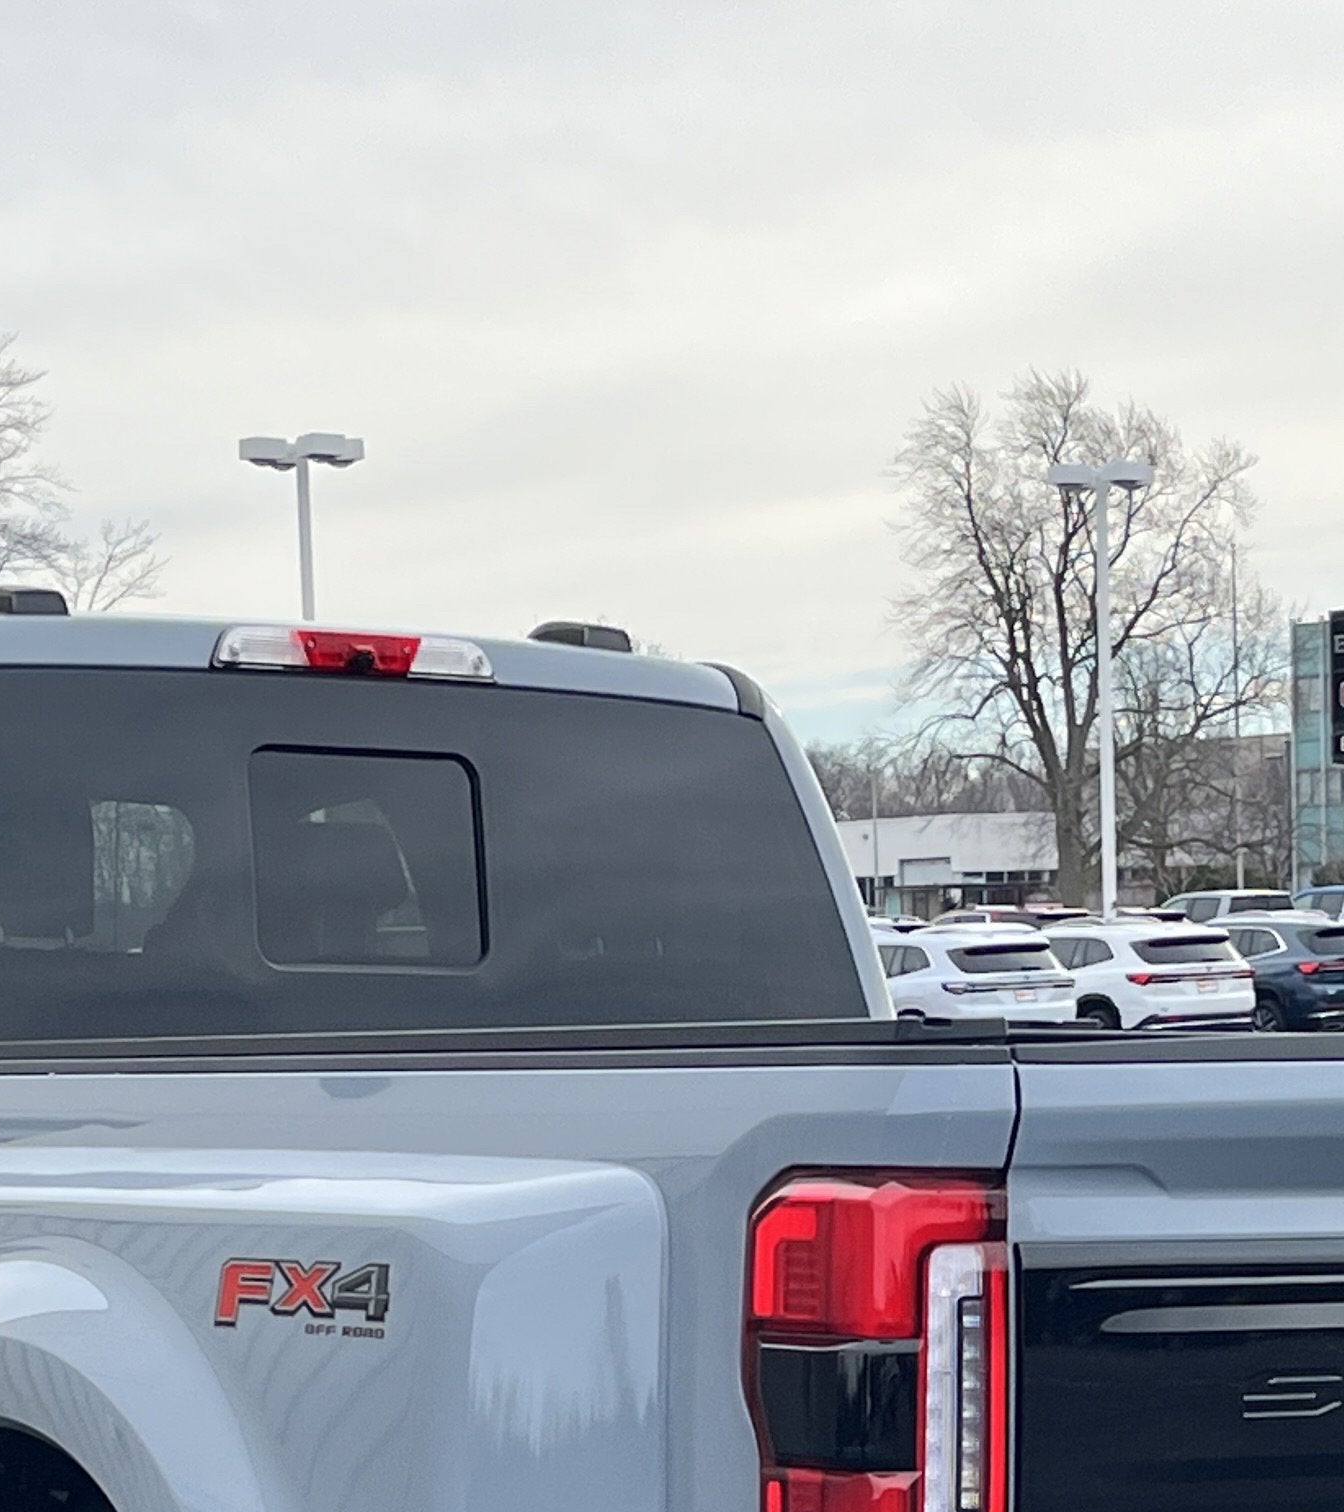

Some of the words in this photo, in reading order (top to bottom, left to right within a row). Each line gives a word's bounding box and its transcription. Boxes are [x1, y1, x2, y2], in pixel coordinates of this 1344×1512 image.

[214, 1257, 390, 1327] FX4
[305, 1323, 337, 1336] OFF
[342, 1326, 385, 1340] ROAD
